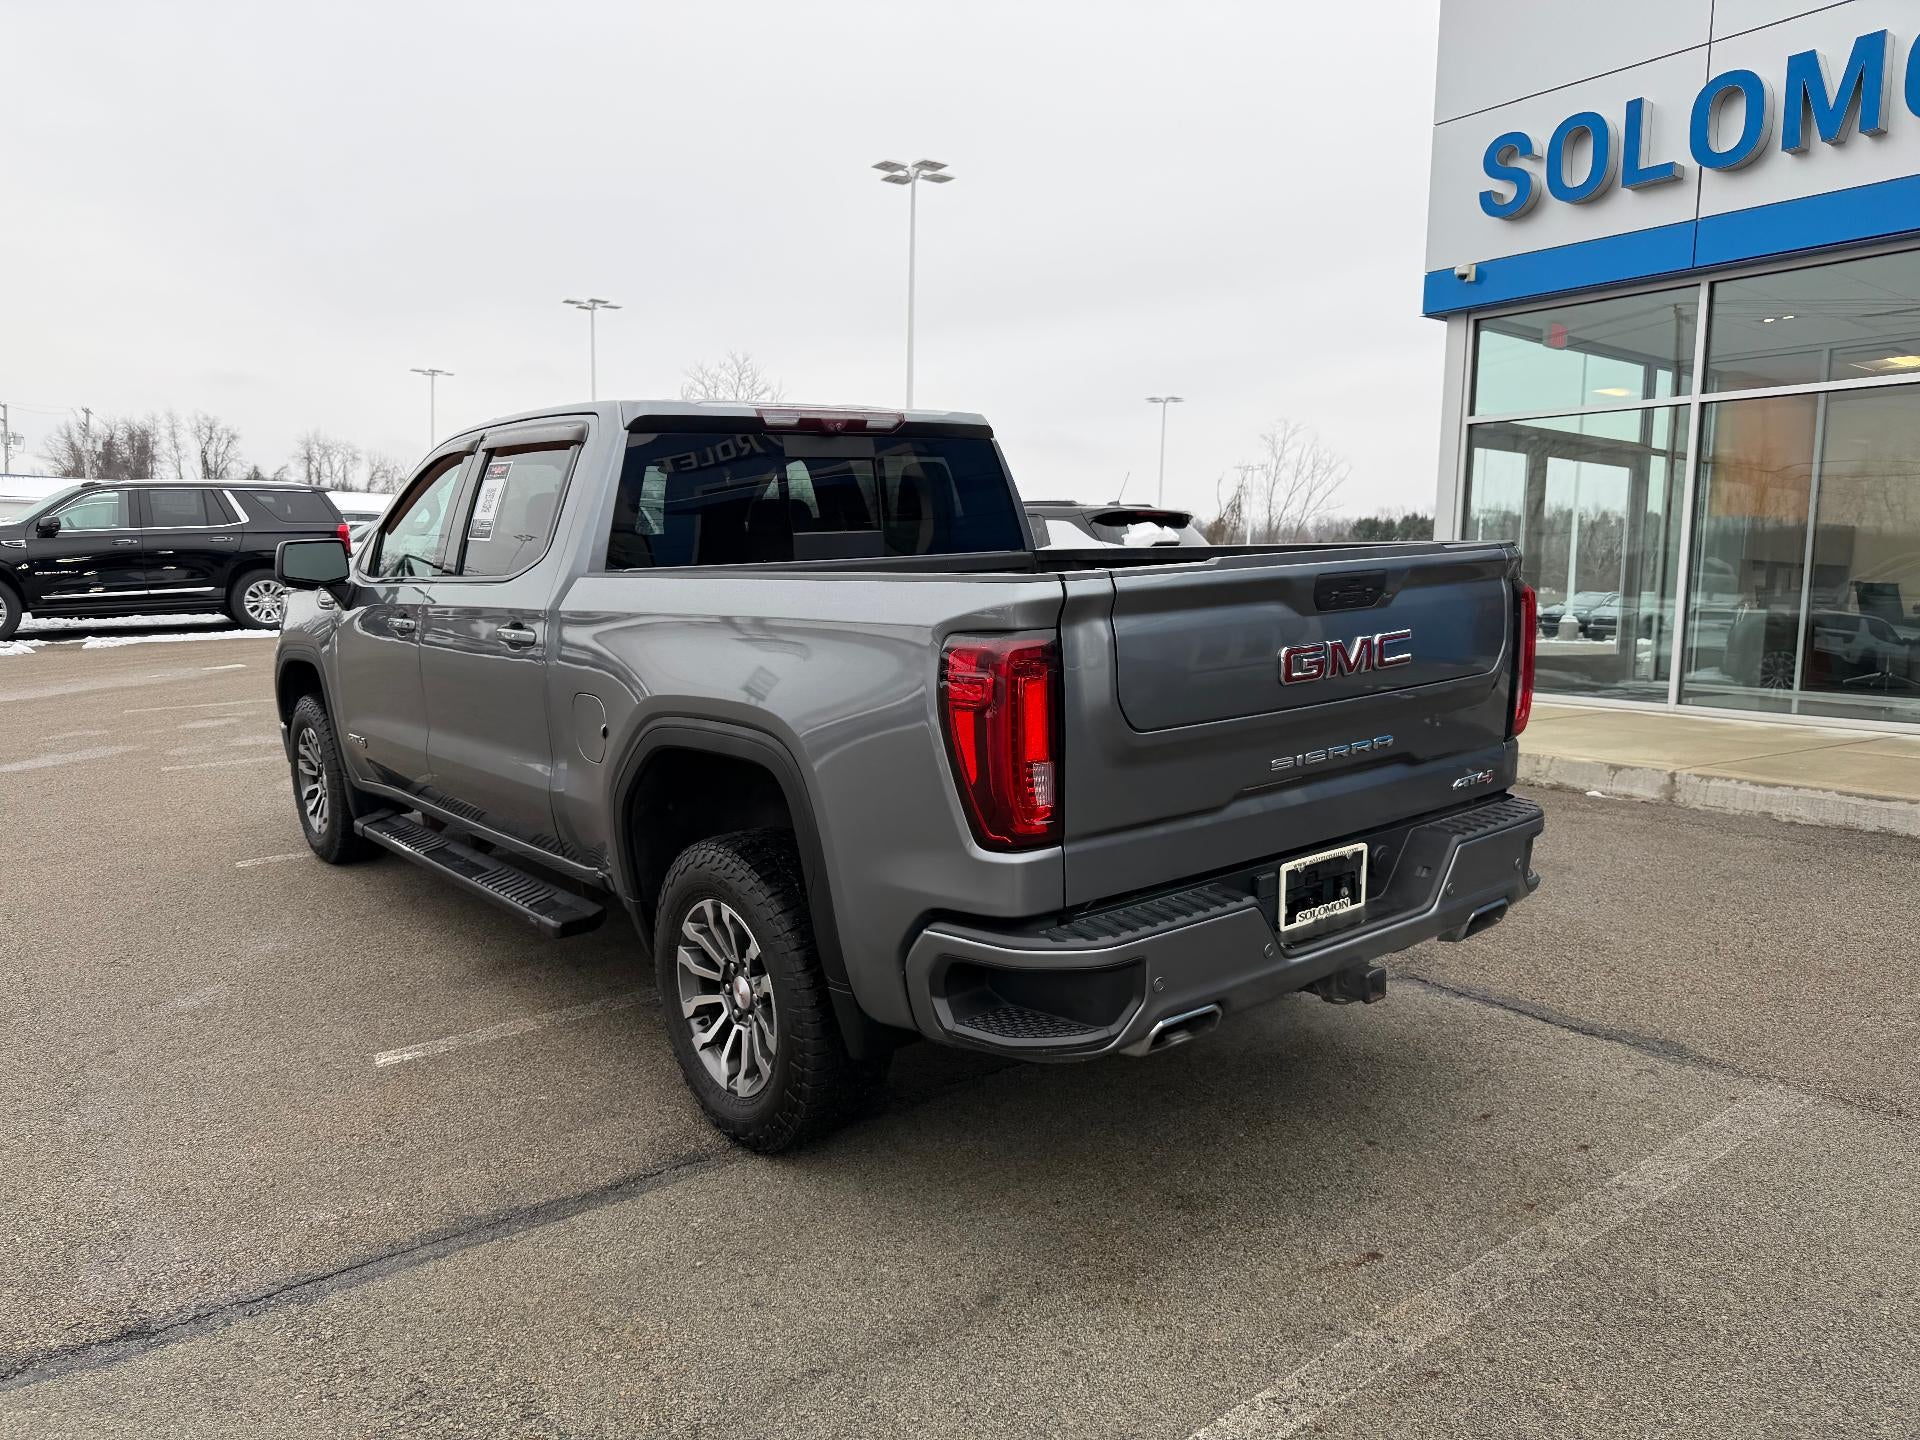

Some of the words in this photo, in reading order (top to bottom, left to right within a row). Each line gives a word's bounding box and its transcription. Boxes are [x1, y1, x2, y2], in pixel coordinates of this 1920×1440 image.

[1278, 628, 1412, 686] GMC
[1270, 735, 1394, 771] SIERRA
[1452, 769, 1494, 790] AT4
[1298, 898, 1350, 922] SOLOMON
